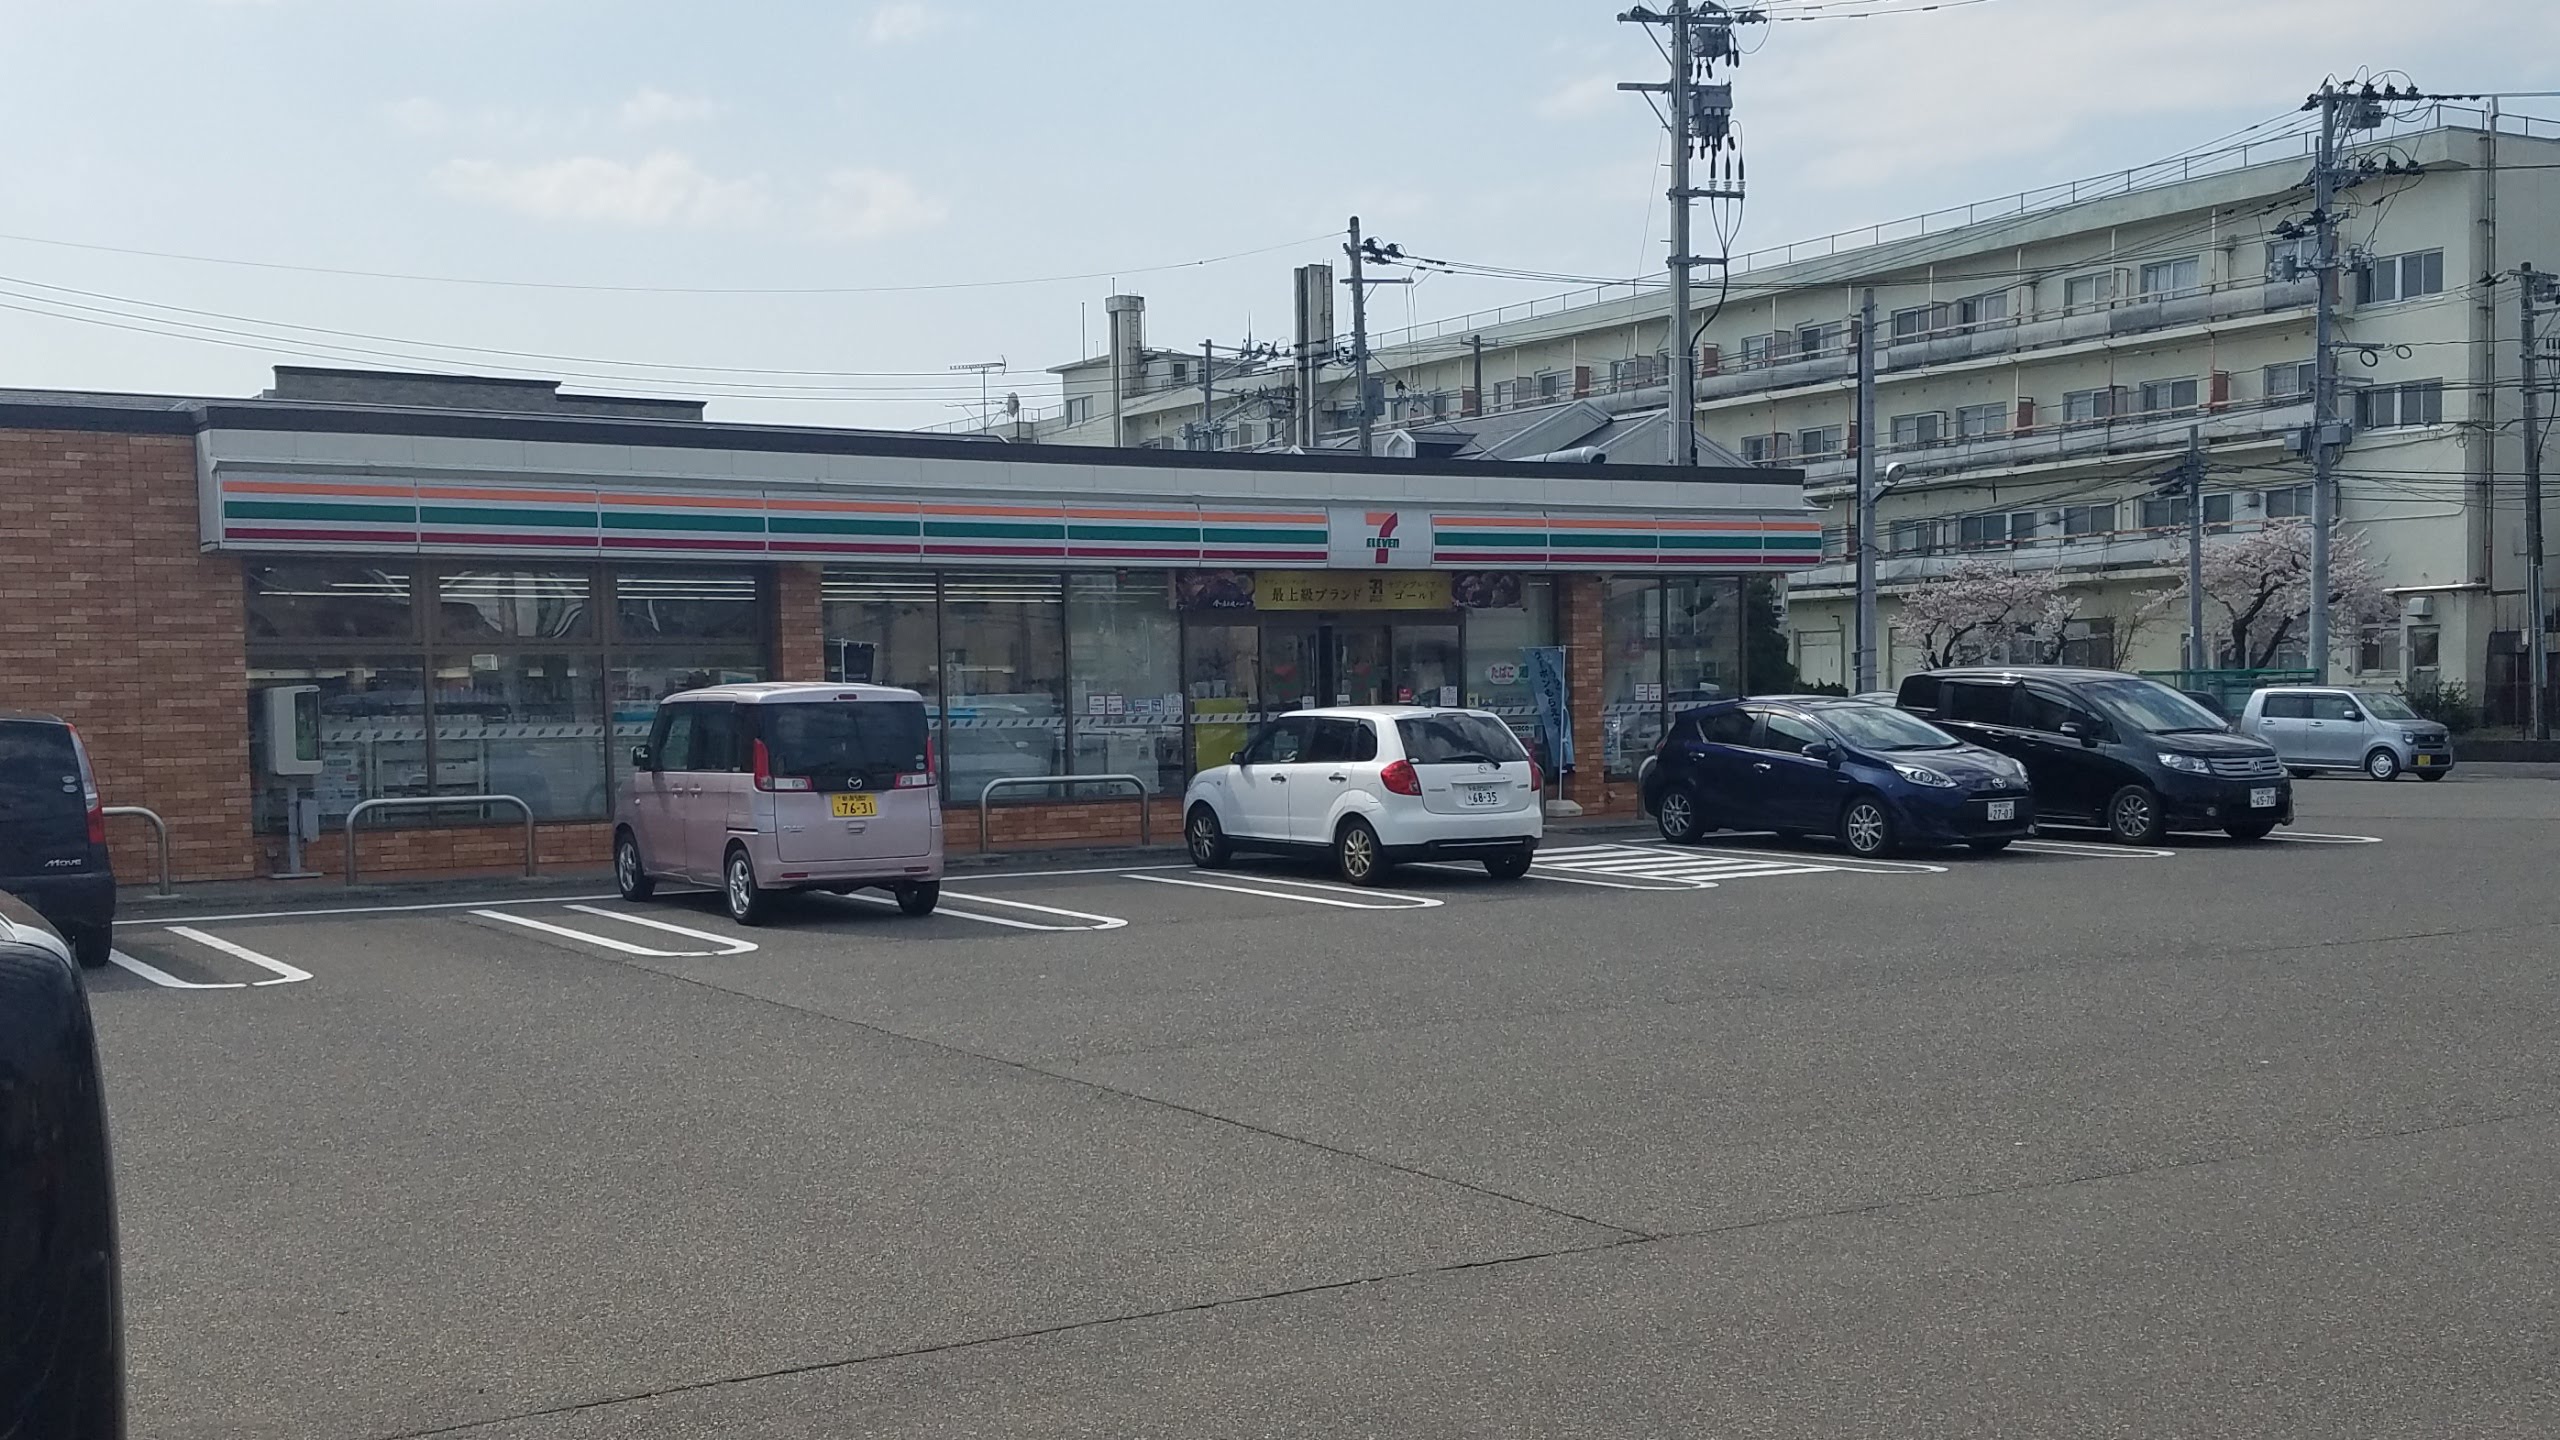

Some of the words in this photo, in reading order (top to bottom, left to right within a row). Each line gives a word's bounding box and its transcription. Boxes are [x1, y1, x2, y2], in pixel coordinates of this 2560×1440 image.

[1271, 586, 1362, 602] 最上級ブランド
[1393, 590, 1438, 601] ゴールド
[1490, 666, 1514, 679] たばこ
[1473, 791, 1498, 803] 68-35
[841, 801, 874, 815] 76-31
